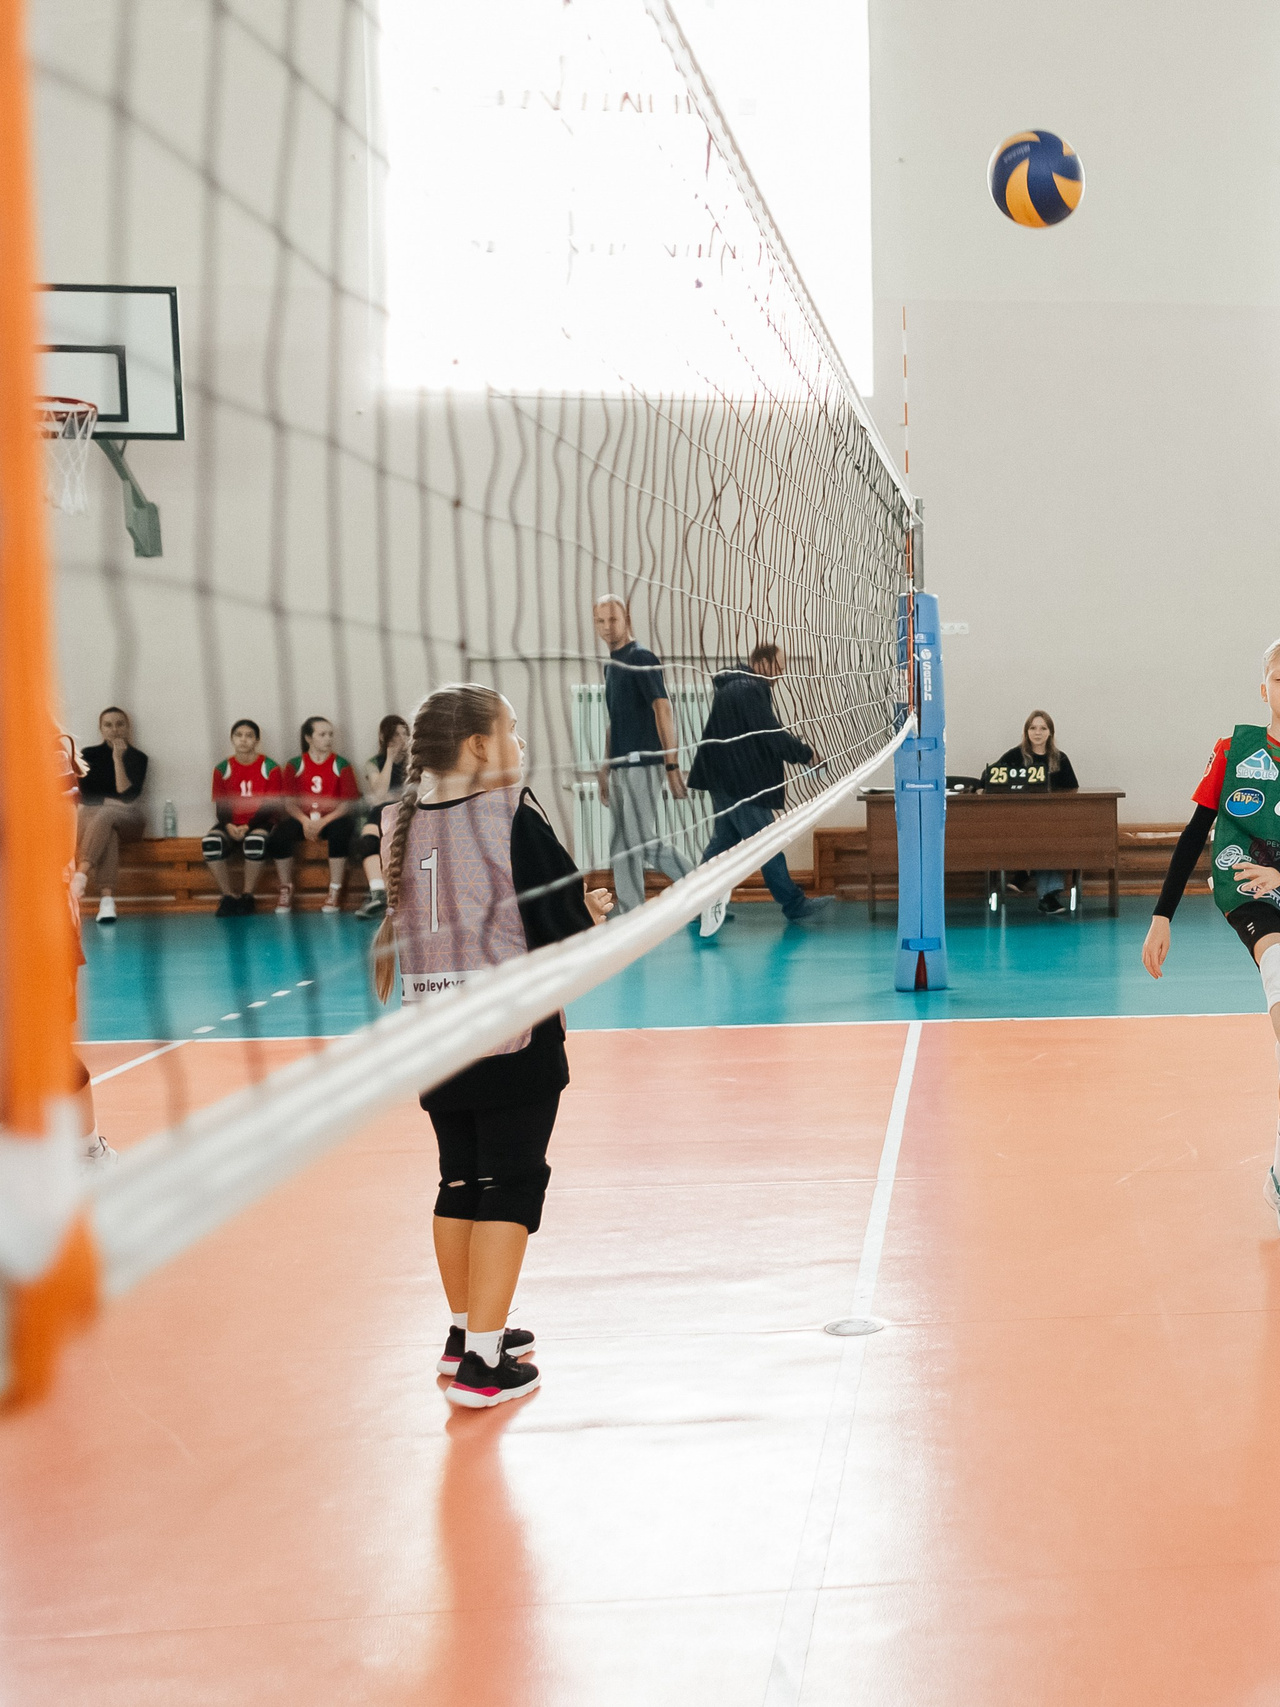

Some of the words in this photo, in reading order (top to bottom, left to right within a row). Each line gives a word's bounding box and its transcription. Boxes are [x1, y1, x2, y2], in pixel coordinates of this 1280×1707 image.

[989, 766, 1008, 784] 25
[1027, 766, 1046, 783] 24
[239, 780, 252, 797] 11
[310, 776, 323, 794] 3
[420, 848, 439, 934] 1
